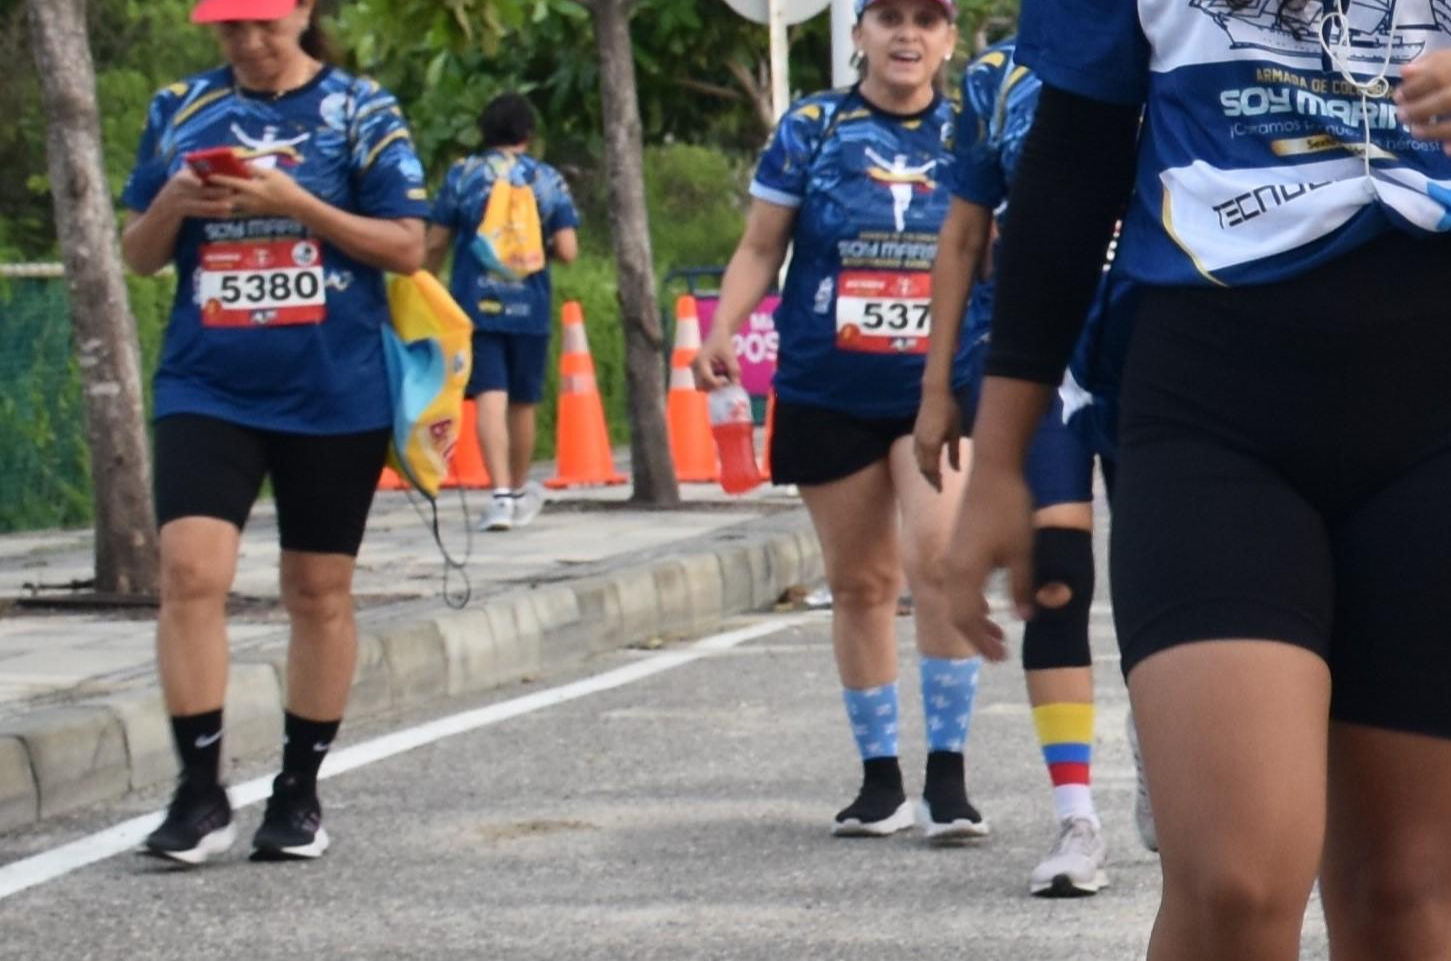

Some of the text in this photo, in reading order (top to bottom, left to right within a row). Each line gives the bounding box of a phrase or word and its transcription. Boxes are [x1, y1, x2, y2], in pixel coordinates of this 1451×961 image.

[1311, 78, 1328, 93] DE
[1220, 87, 1293, 117] SOY
[220, 271, 319, 304] 5380
[862, 302, 931, 330] 537
